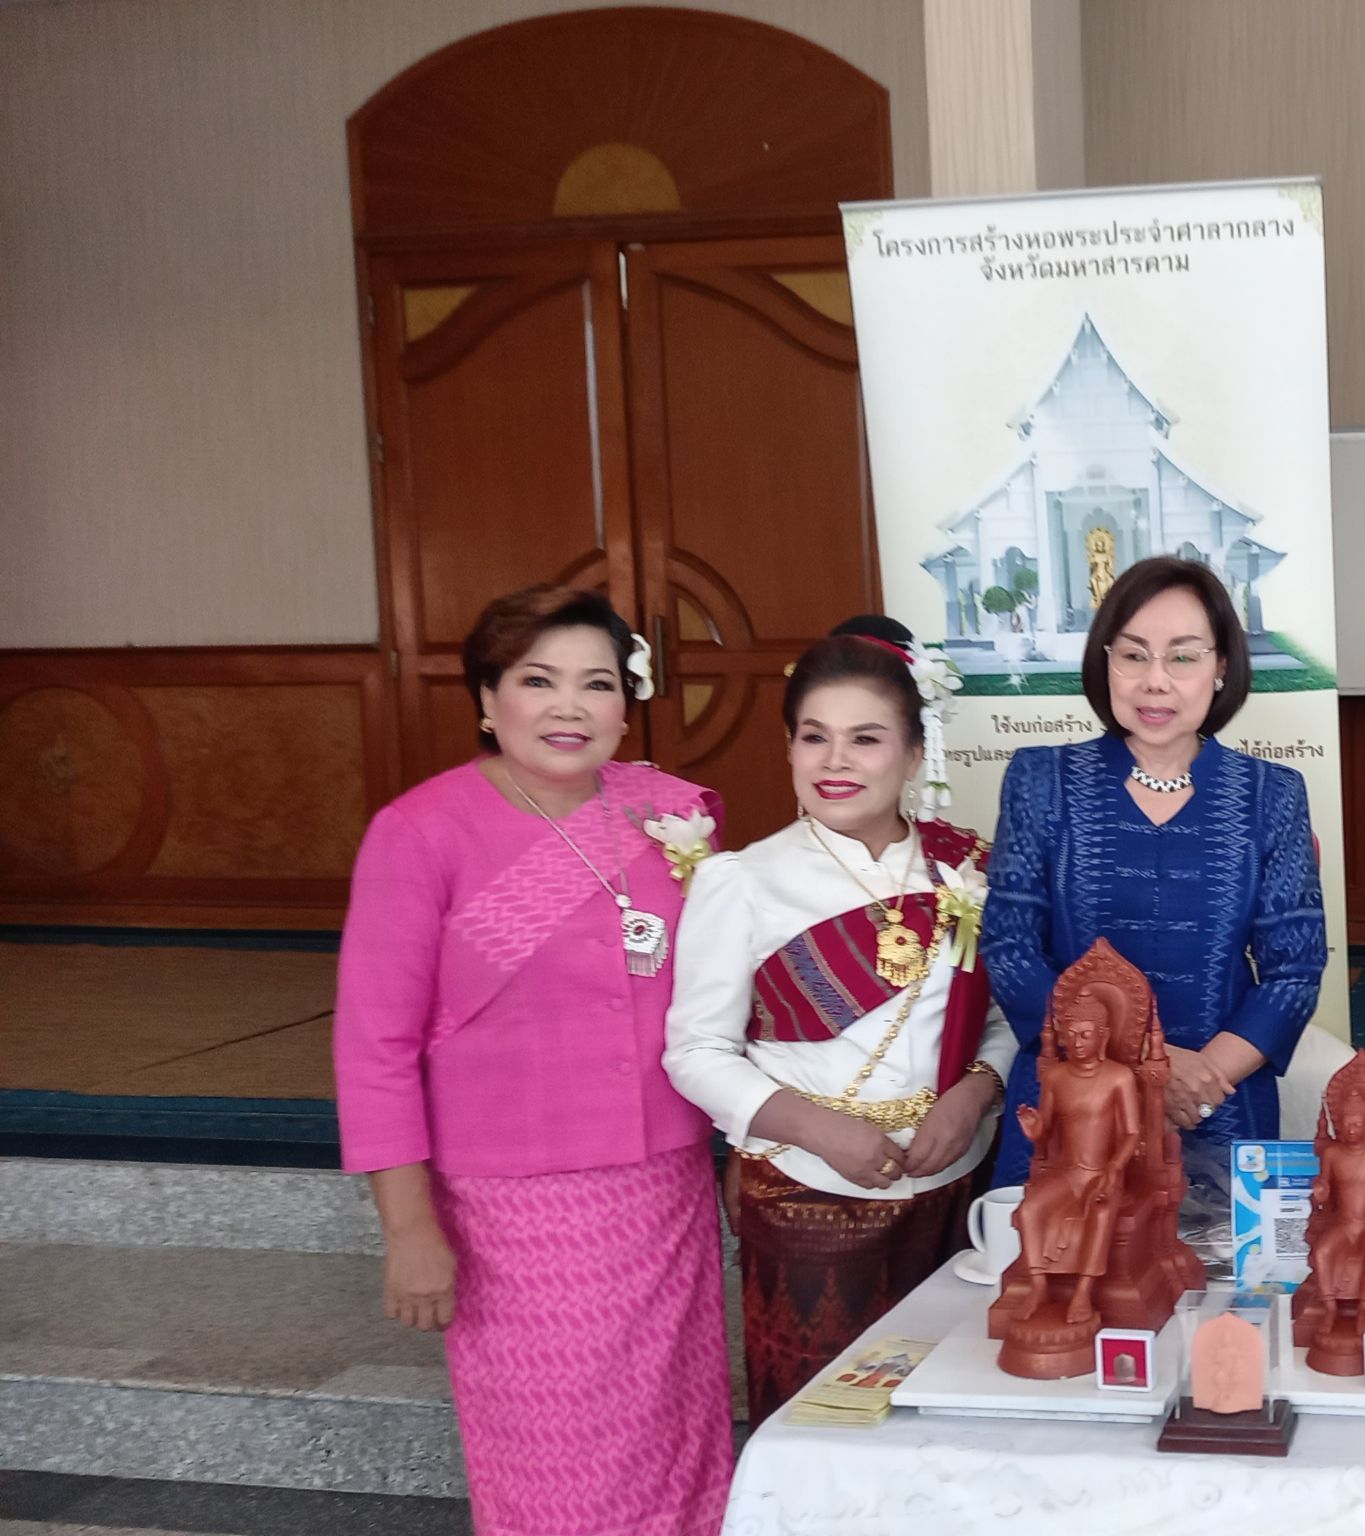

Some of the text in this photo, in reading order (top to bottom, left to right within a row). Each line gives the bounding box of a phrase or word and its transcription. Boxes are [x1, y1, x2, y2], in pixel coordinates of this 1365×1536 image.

[872, 217, 1295, 257] โครงการสร้างหอพระประจำศาลากลาง
[979, 252, 1190, 281] จังหวัดมหาสารคาม
